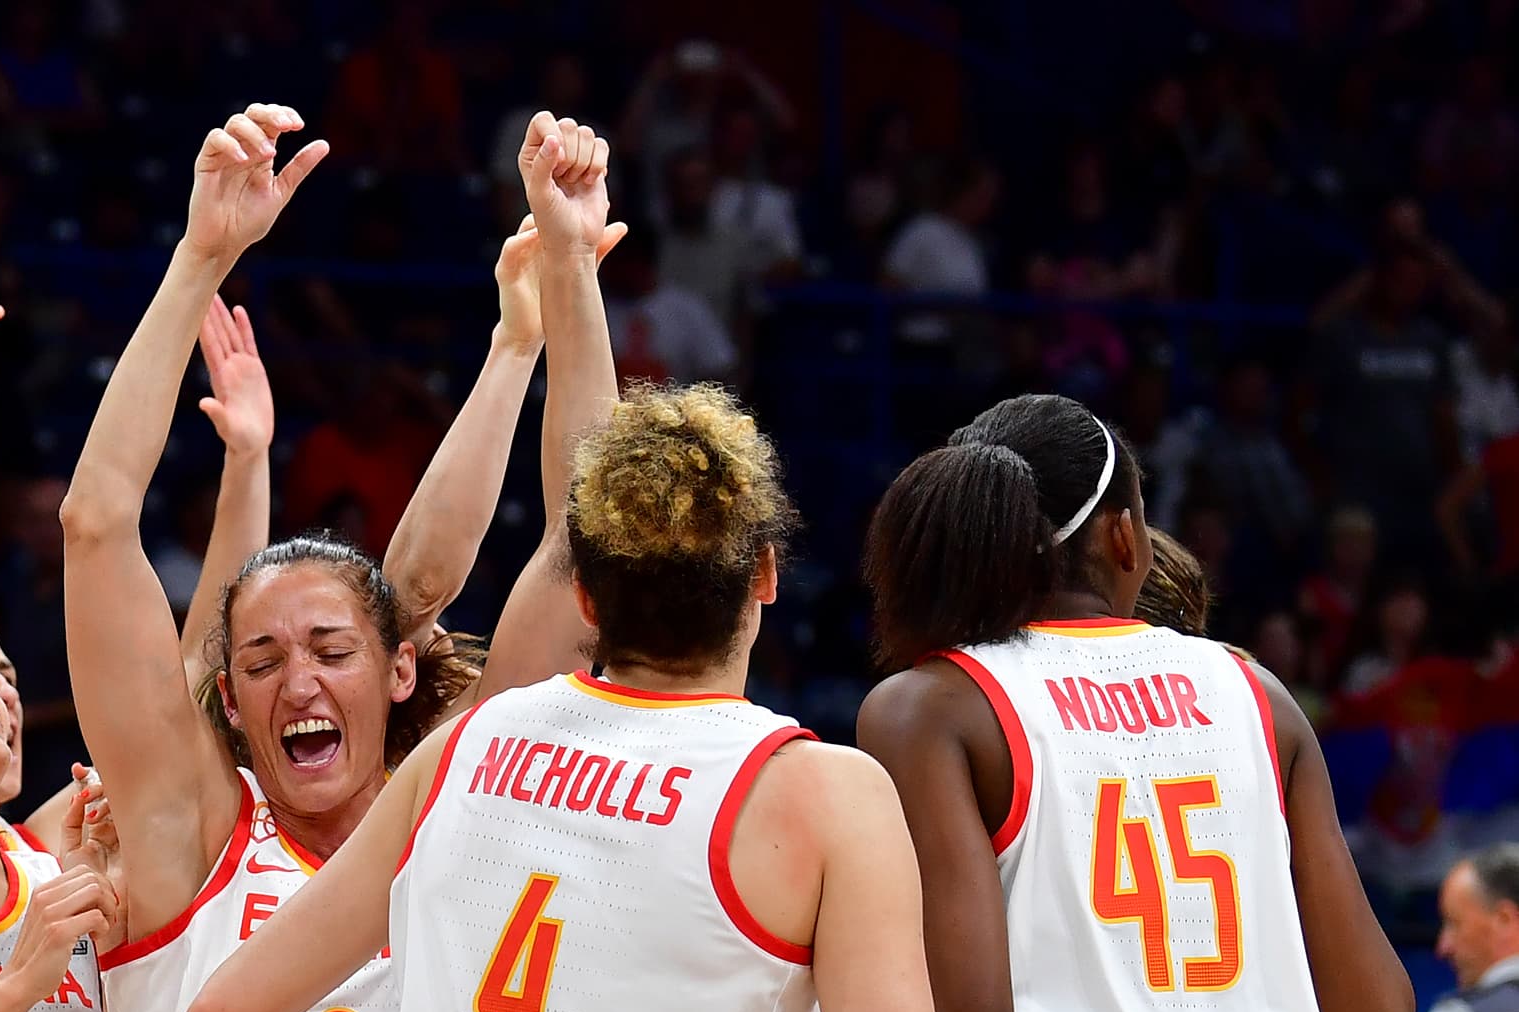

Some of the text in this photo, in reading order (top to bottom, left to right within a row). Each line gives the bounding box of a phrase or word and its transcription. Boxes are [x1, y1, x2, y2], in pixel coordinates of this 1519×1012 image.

[1045, 673, 1212, 733] NDOUR
[468, 737, 692, 826] NICHOLLS
[1090, 774, 1244, 993] 45
